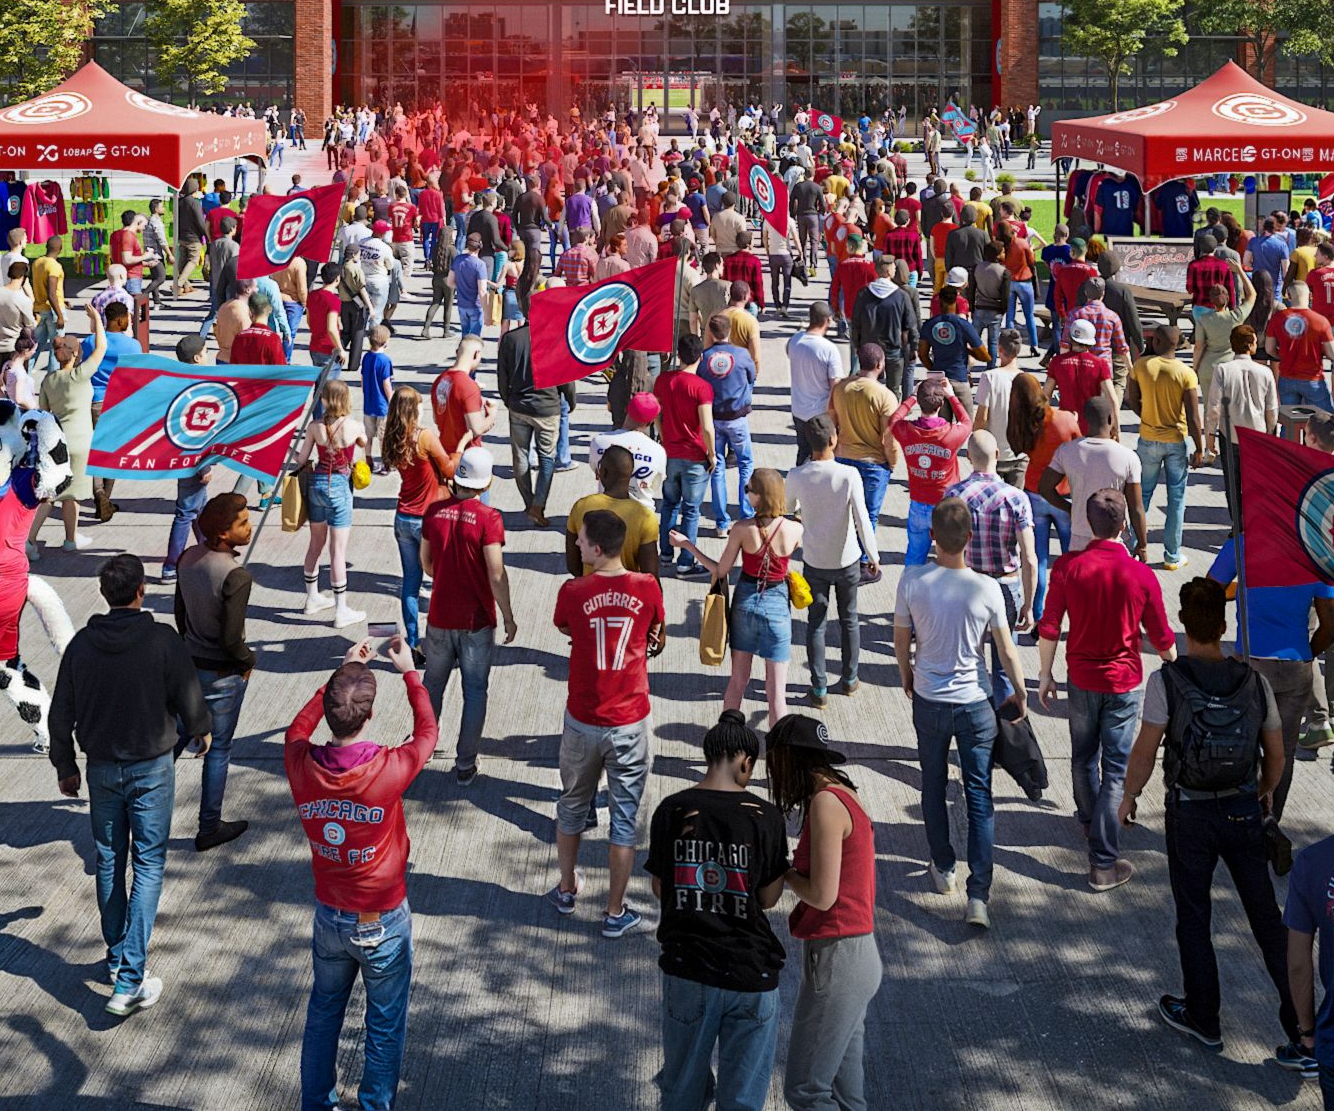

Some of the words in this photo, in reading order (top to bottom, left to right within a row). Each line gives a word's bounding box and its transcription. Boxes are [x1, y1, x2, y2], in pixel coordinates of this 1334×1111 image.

[63, 147, 92, 157] LOBAP
[110, 145, 150, 157] GT-ON
[1261, 148, 1301, 160] GT-ON
[119, 455, 156, 469] FAN
[210, 441, 251, 464] LIFE
[583, 592, 644, 616] GUTIÉRREZ
[589, 617, 635, 671] 17
[299, 799, 385, 825] CHICAGO
[348, 846, 377, 866] FC
[673, 839, 749, 869] CHICAGO
[675, 889, 748, 920] FIRE
